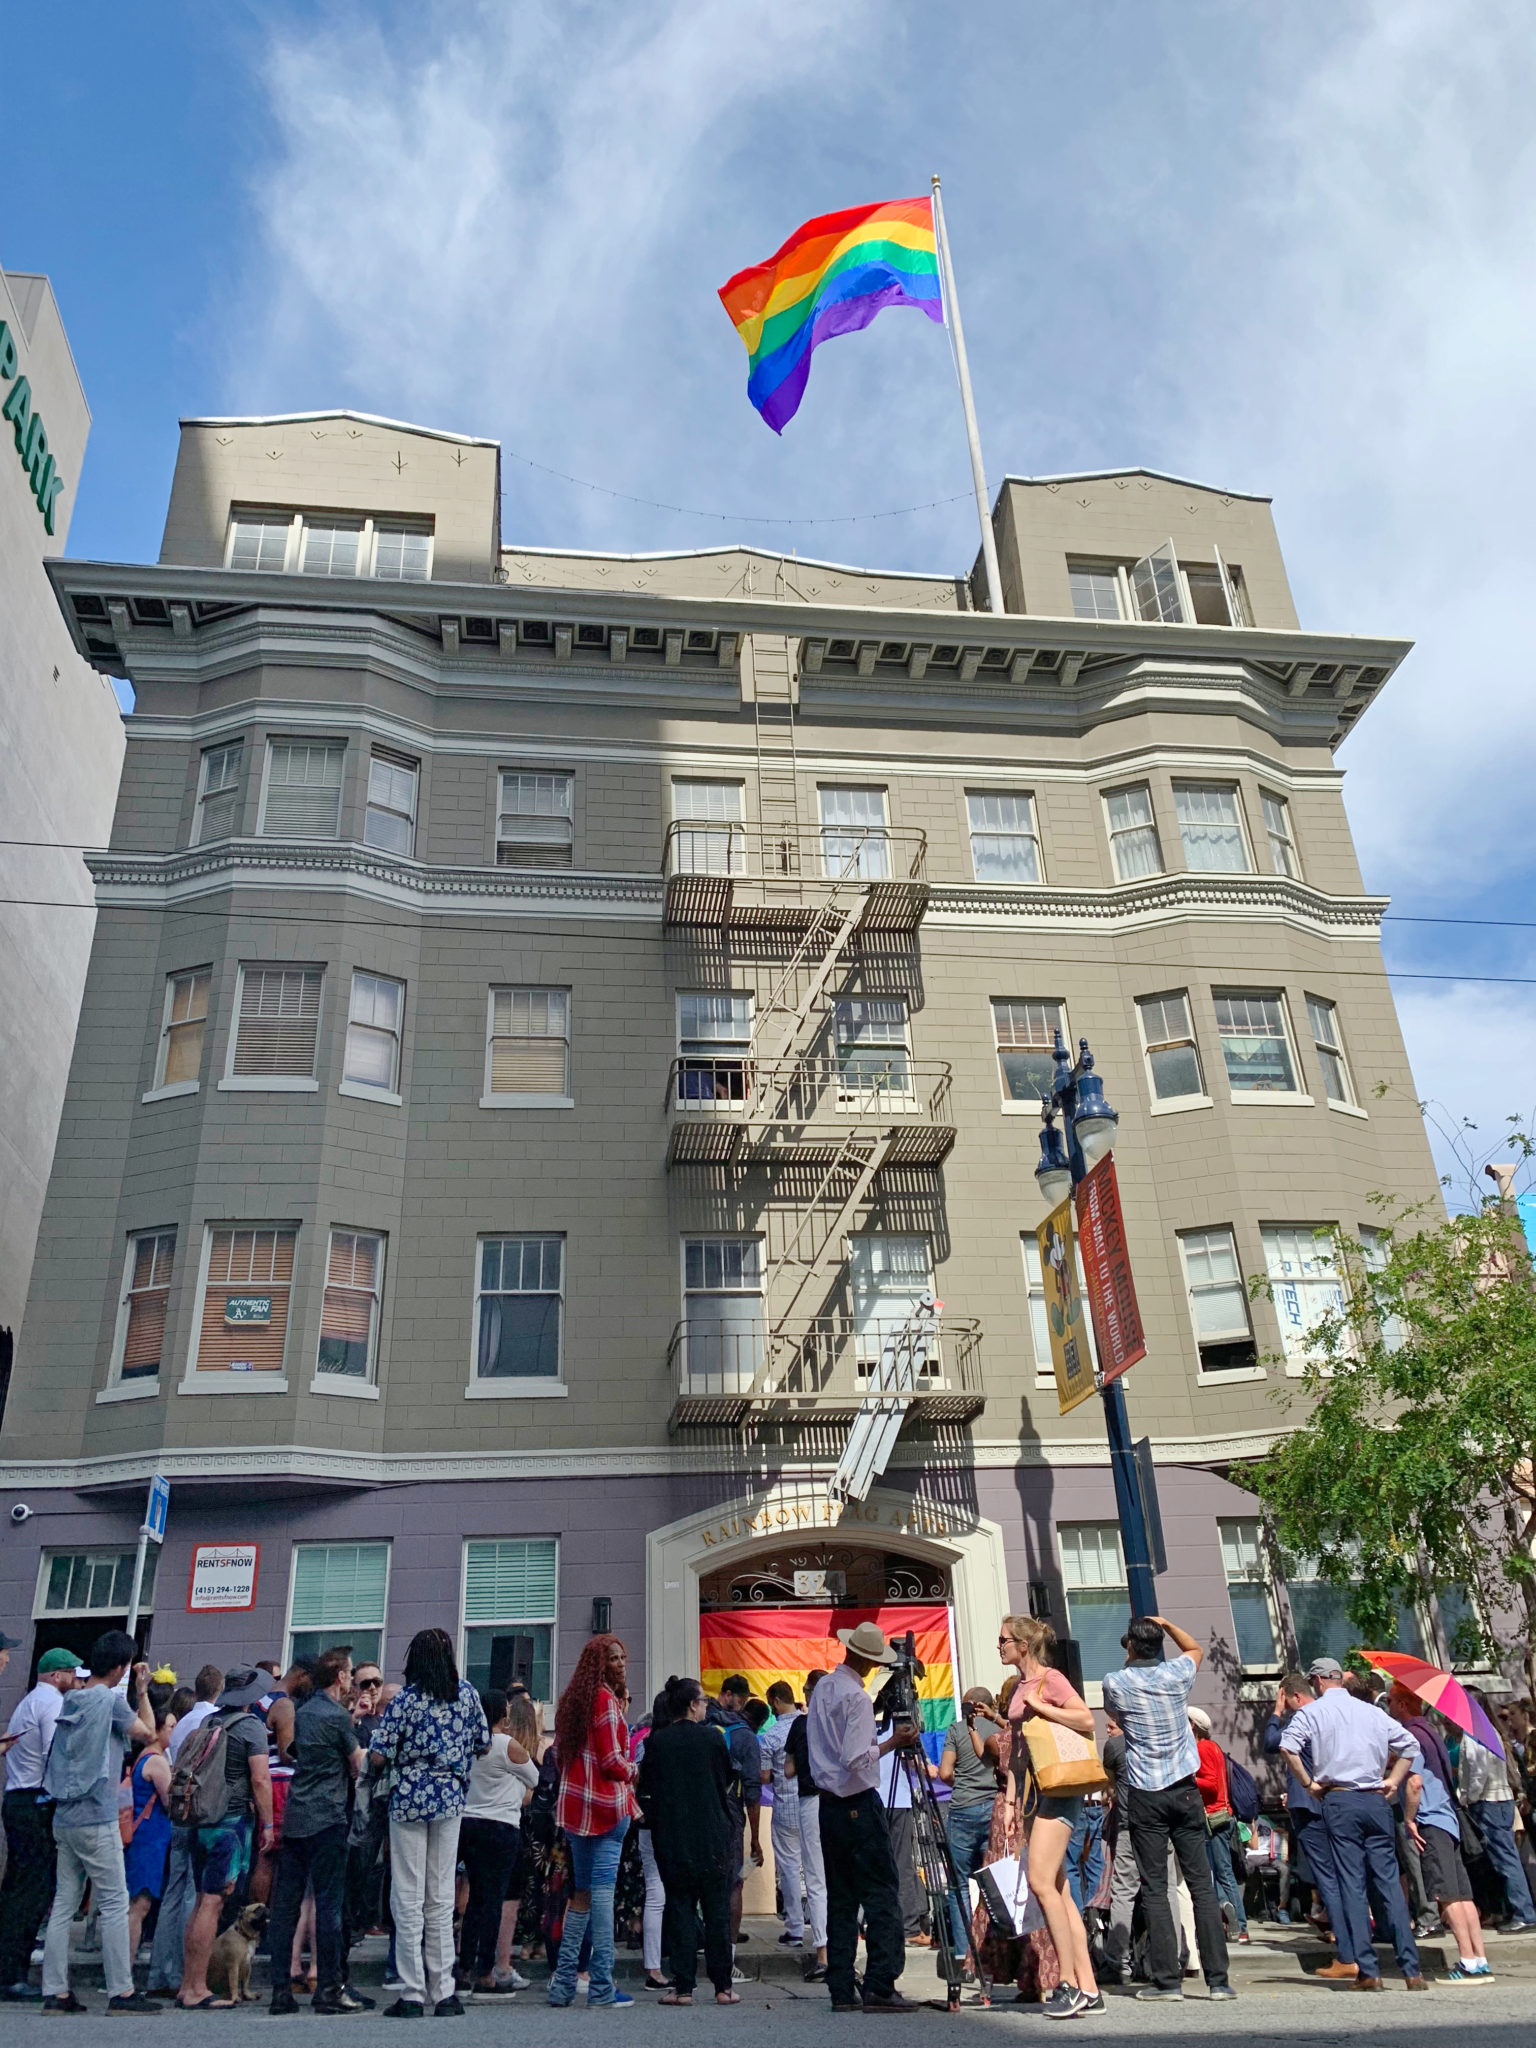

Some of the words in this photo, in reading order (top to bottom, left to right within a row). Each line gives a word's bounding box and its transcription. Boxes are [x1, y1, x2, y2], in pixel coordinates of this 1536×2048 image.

[0, 320, 65, 536] PARK
[1088, 1179, 1101, 1222] FROM
[1093, 1220, 1106, 1257] WALT
[1098, 1164, 1123, 1257] MICKEY
[1114, 1260, 1140, 1354] MOUSE
[1099, 1260, 1110, 1280] TO
[250, 1305, 269, 1313] FAN
[1103, 1282, 1114, 1310] THE
[1107, 1310, 1124, 1364] WORLD
[701, 1504, 812, 1547] RAINBOW
[822, 1503, 880, 1523] FLAG
[197, 1558, 253, 1568] RENTSFNOW
[195, 1586, 215, 1596] (415)
[217, 1585, 250, 1593] 294-1228
